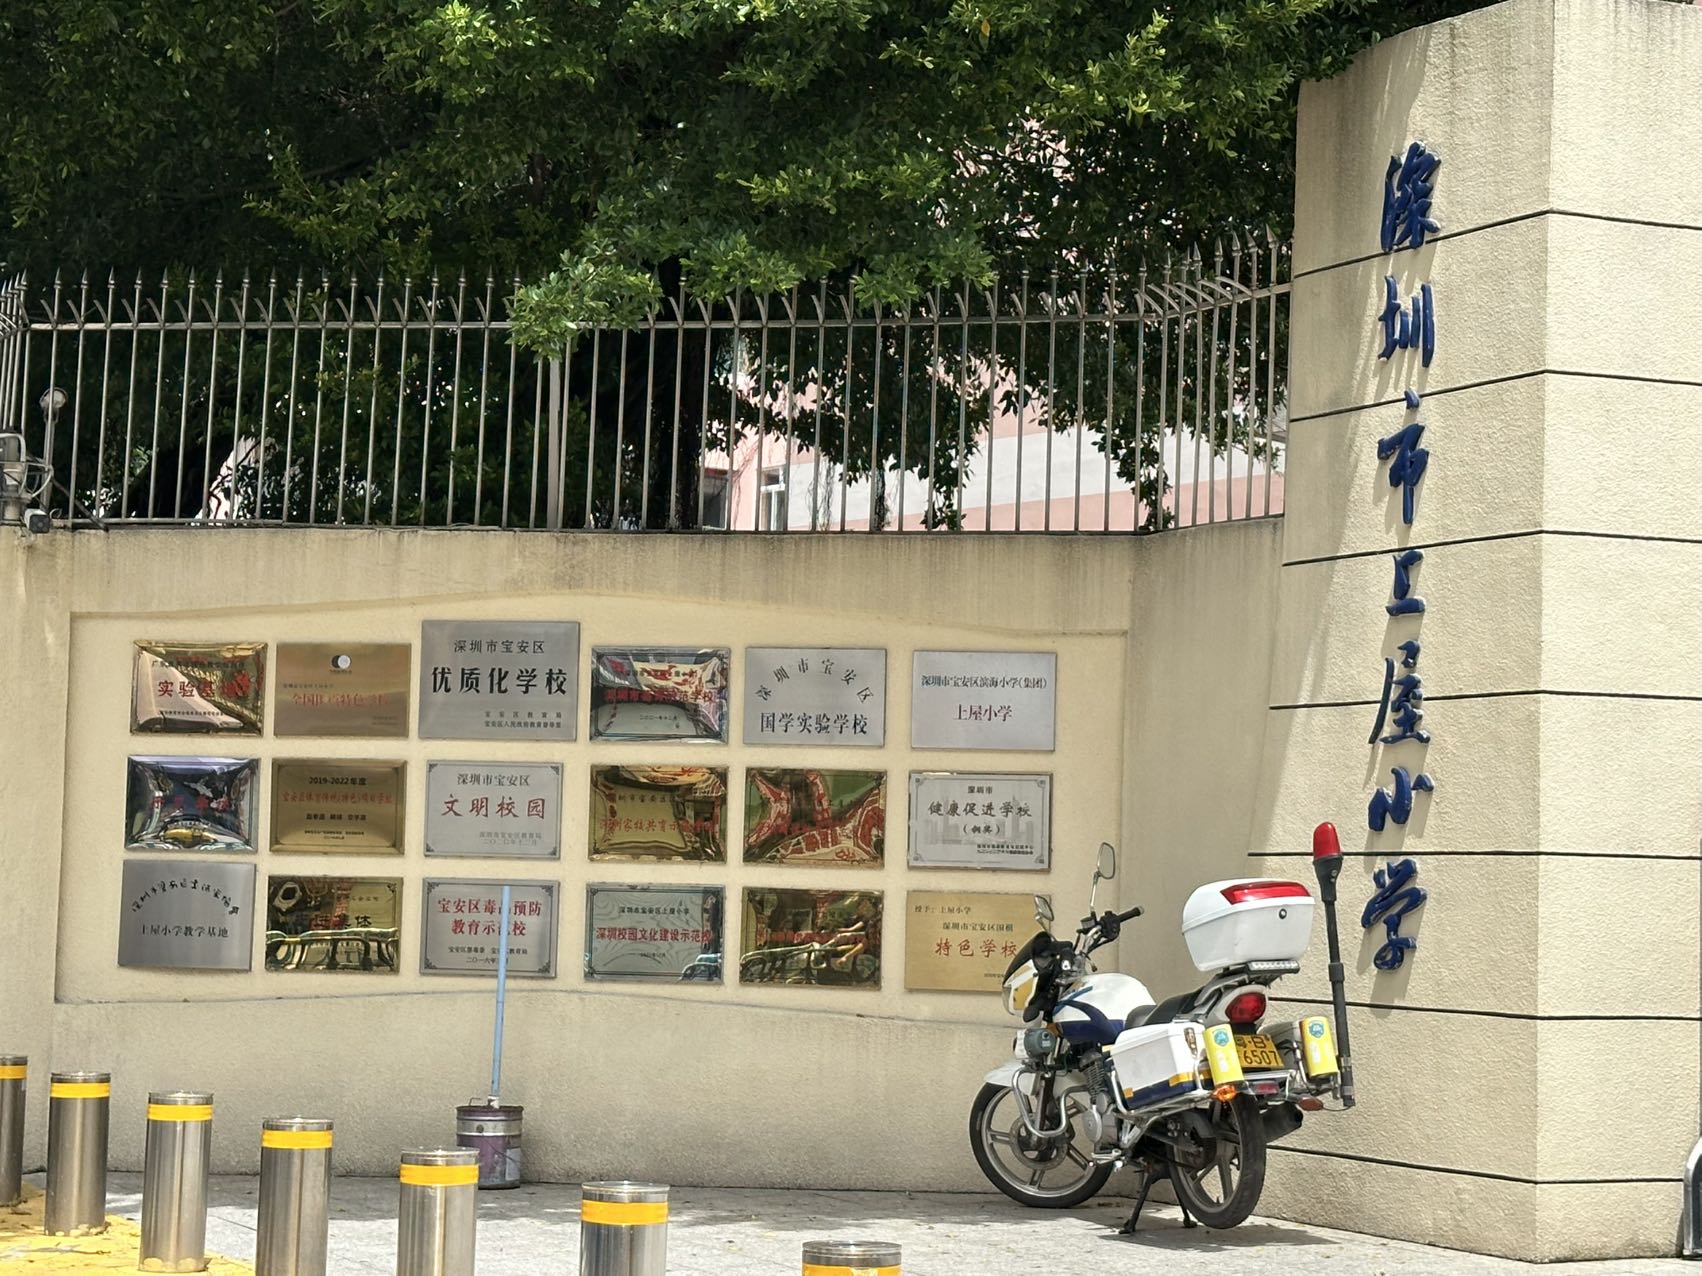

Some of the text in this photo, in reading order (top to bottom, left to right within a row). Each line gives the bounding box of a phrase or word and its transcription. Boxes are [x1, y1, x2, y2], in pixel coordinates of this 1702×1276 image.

[1361, 140, 1441, 972] 深圳市上屋小学
[453, 639, 546, 654] 深圳市宝安区
[431, 666, 568, 695] 优质化学校
[755, 658, 874, 704] 深圳市宝安区
[953, 703, 1013, 722] 上屋小学
[760, 712, 868, 735] 国学实验学校
[456, 772, 531, 787] 深圳市宝安区
[967, 785, 993, 795] 深圳市
[441, 793, 546, 820] 文明校园
[927, 800, 1033, 818] 健康促进学校
[437, 897, 543, 917] 宝安区毒预防
[142, 923, 229, 938] 上屋小学教学基地
[490, 947, 529, 955] 宝教育局
[934, 937, 1018, 959] 特色学校
[1240, 1049, 1279, 1066] 6507
